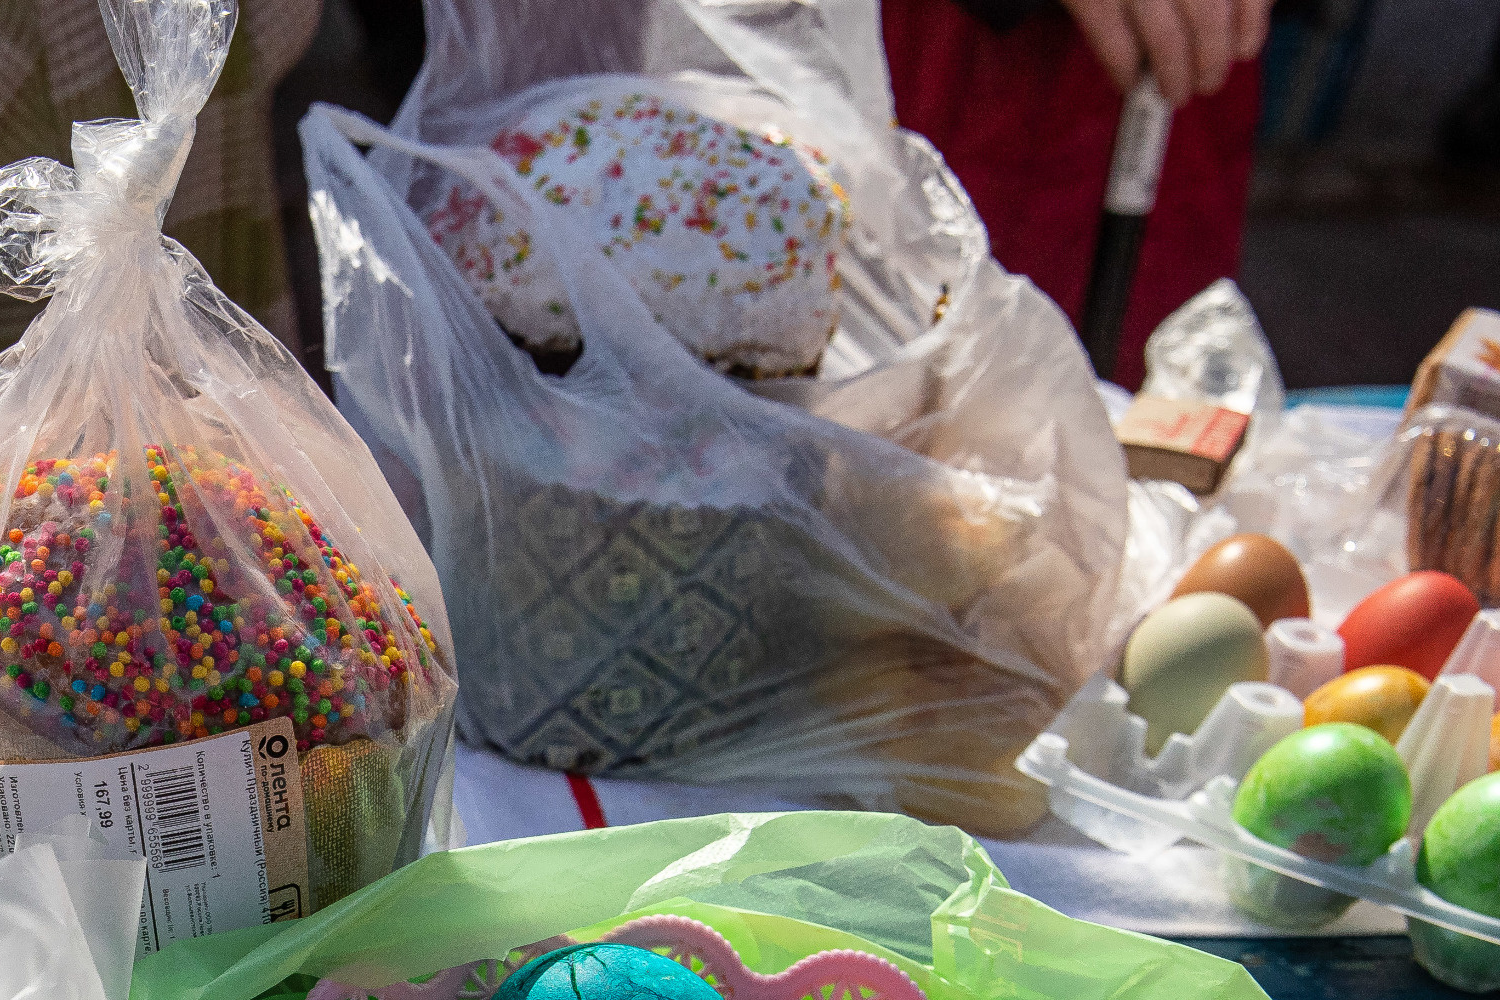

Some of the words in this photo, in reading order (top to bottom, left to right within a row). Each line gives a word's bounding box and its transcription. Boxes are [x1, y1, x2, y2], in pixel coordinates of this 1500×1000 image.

[117, 766, 129, 792] Цена
[239, 740, 255, 775] Кулич
[74, 771, 86, 809] Условия
[94, 780, 114, 829] 167,99
[123, 794, 133, 812] без
[195, 750, 211, 811] Количество
[203, 822, 218, 871] упаковке:
[260, 765, 275, 833] по-домашнему
[270, 763, 292, 832] лента
[124, 815, 137, 848] карты,
[140, 779, 156, 821] 999999
[148, 827, 164, 869] 655569
[246, 778, 265, 857] Праздничный
[254, 858, 270, 906] (Россия)
